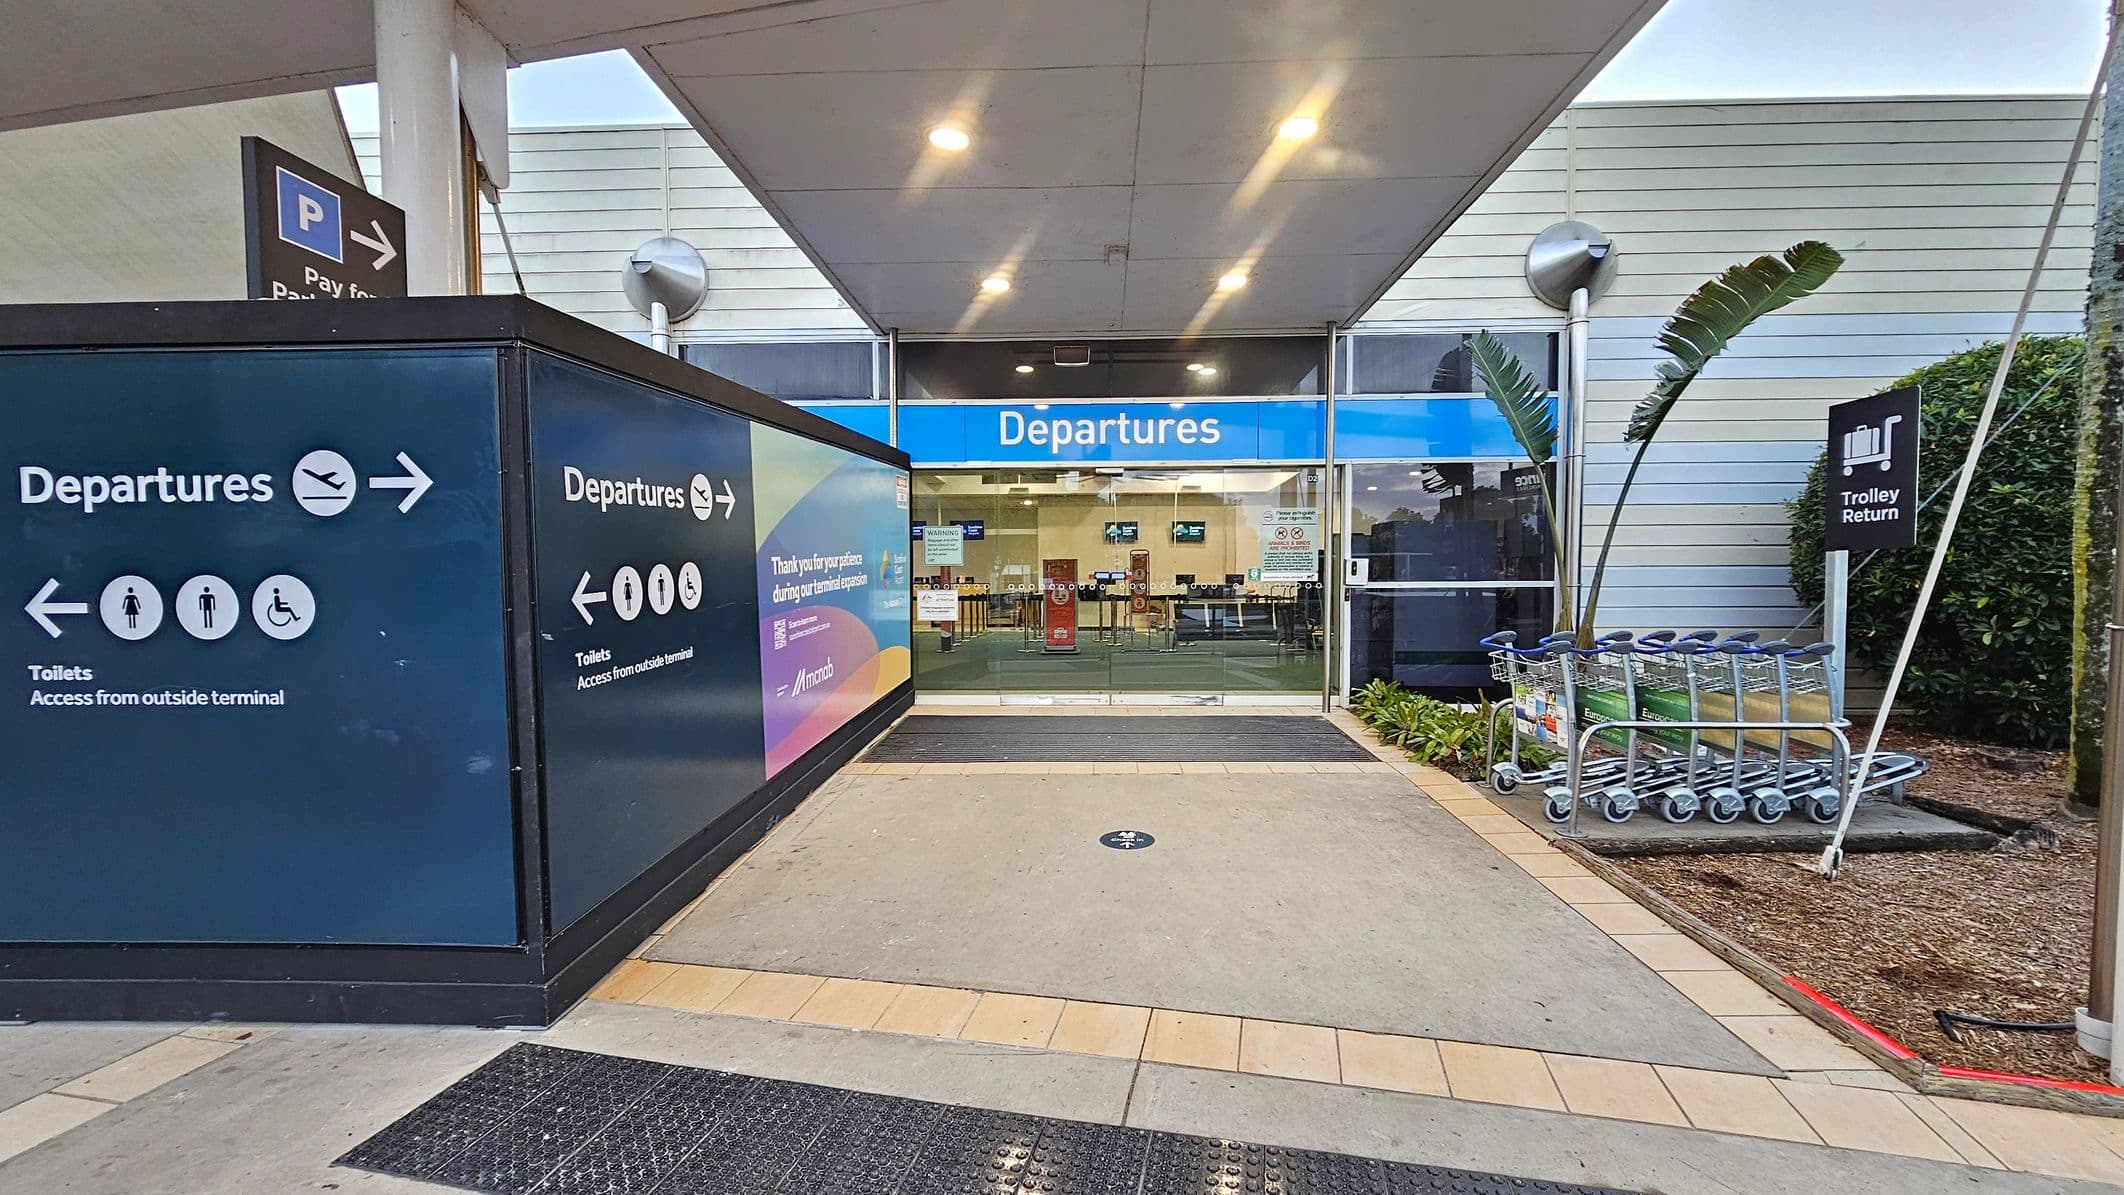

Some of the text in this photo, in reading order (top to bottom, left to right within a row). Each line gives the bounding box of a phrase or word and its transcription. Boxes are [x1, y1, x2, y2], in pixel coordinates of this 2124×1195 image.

[298, 193, 324, 232] P
[304, 266, 344, 299] Pay
[999, 410, 1222, 454] Departures
[19, 466, 274, 513] Departures
[563, 465, 685, 513] Departures
[1840, 488, 1900, 506] Trolley
[1842, 507, 1899, 523] Return
[771, 551, 862, 577] Thank you for your patience
[773, 571, 868, 603] during our terminal expansion
[575, 648, 612, 668] Toilets
[576, 646, 694, 691] Access from outside terminal
[805, 655, 834, 689] mcnab
[28, 665, 93, 681] Toilets
[29, 689, 285, 706] Access from outside terminal
[1584, 707, 1615, 723] Europc
[1642, 707, 1679, 722] Europc
